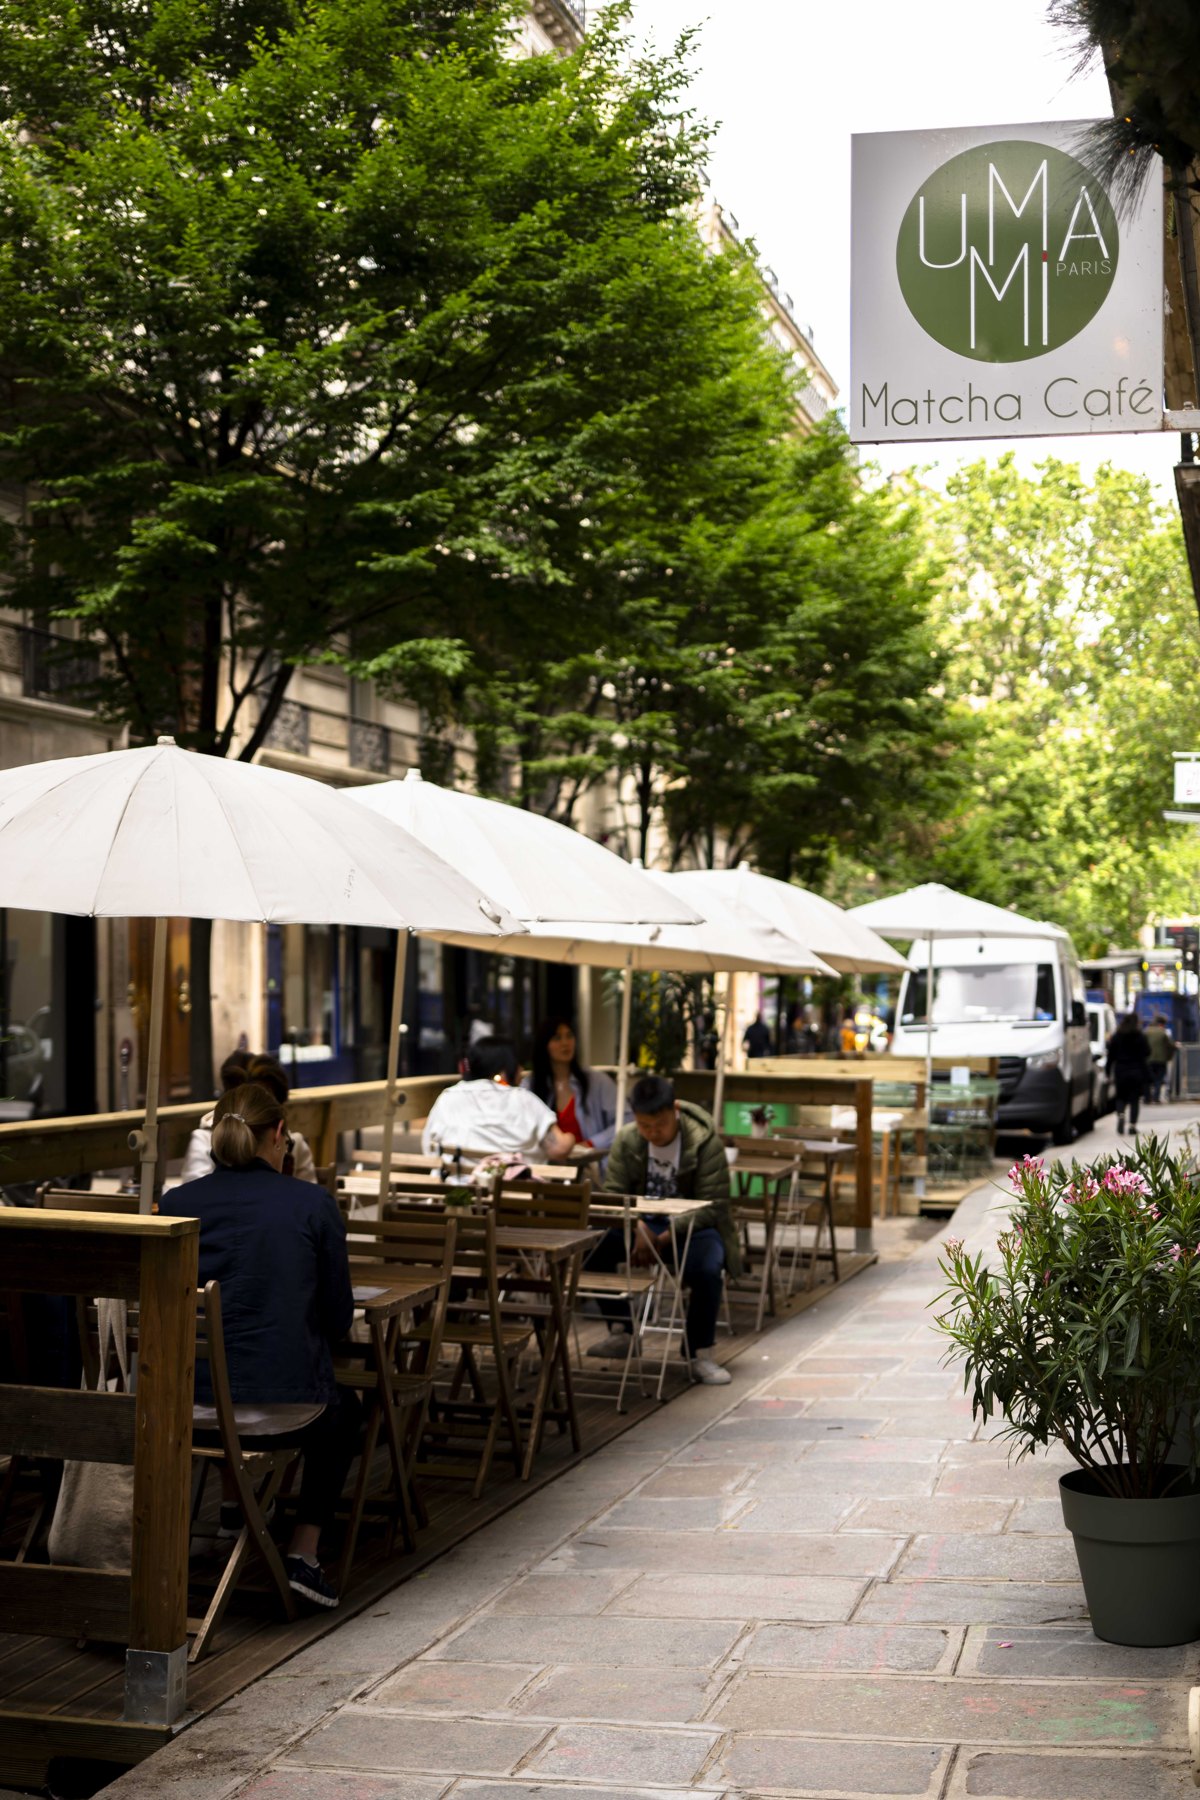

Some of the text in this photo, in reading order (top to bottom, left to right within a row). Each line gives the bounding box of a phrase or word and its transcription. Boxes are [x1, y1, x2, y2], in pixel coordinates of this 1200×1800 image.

[1056, 260, 1112, 277] PARIS
[862, 376, 1154, 428] Matcha Café
